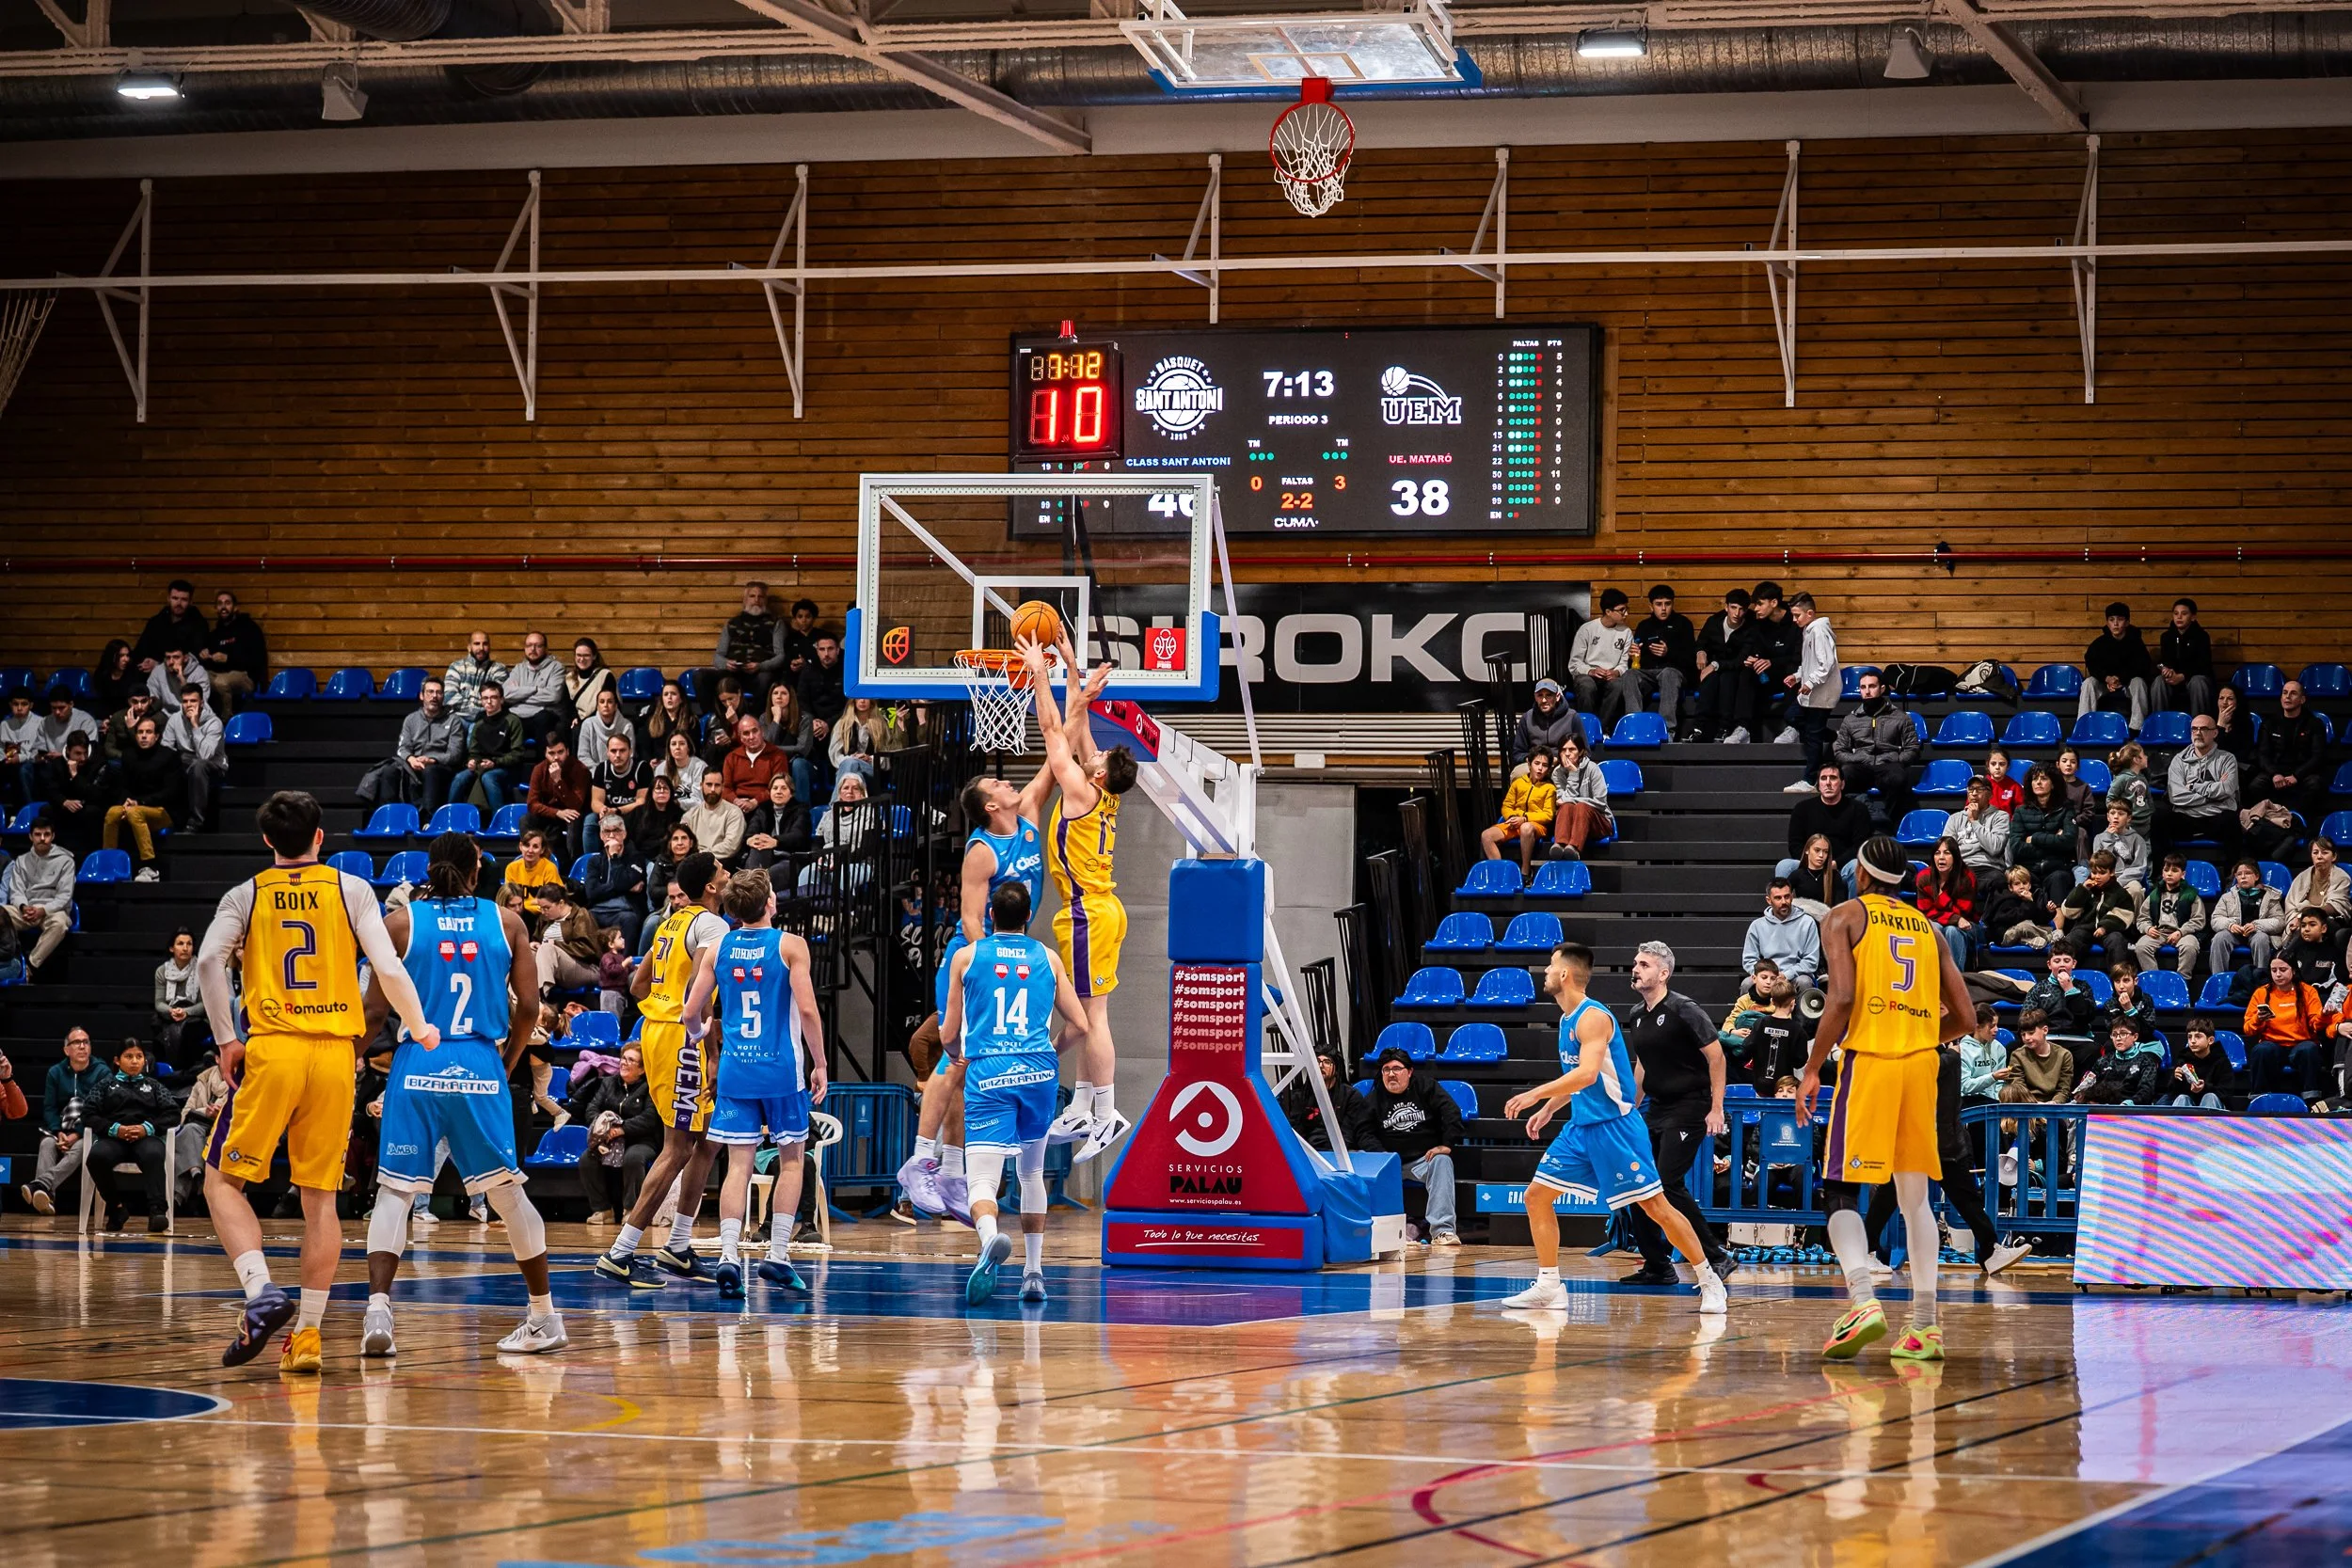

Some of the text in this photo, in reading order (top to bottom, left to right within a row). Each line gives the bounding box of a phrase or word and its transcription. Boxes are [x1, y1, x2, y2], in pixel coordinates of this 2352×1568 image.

[1497, 352, 1563, 361] 0 5
[1497, 364, 1563, 374] 2 2
[1263, 370, 1335, 398] 7:13
[1497, 378, 1563, 387] 5 4
[1136, 387, 1223, 412] SANT ANTONI
[1497, 391, 1562, 401] 6 0
[1048, 386, 1103, 444] 10
[1381, 396, 1462, 425] UEM
[1497, 404, 1563, 413] 8 7
[1269, 415, 1328, 425] PERIODO 3
[1497, 417, 1562, 426] 9 0
[1492, 430, 1562, 439] 15 4
[1248, 439, 1261, 448] TM
[1336, 438, 1349, 447] TM
[1555, 443, 1562, 451] 5
[1126, 457, 1232, 467] CLASS SANT ANTONI
[1389, 452, 1453, 464] UE. MATARÓ
[1554, 456, 1562, 465] 0
[1041, 461, 1110, 470] 19 0
[1281, 477, 1314, 485] FALTAS
[1492, 469, 1561, 479] 50 11
[1250, 476, 1263, 492] 0
[1334, 475, 1346, 490] 3
[1492, 483, 1562, 491] 98 0
[1041, 499, 1110, 510] 99 0
[1280, 492, 1313, 509] 2-2
[1390, 479, 1450, 516] 38
[1491, 496, 1562, 505] 99 0
[274, 891, 319, 911] BOIX
[1869, 910, 1930, 934] GARRIDO
[281, 919, 318, 990] 2
[729, 945, 767, 960] JOHNSON
[1889, 934, 1915, 992] 5
[1174, 970, 1246, 985] #somsport
[1174, 984, 1246, 998] #somsport
[284, 1001, 349, 1015] Romauto
[450, 972, 473, 1036] 2
[1173, 998, 1245, 1012] #somsport
[740, 990, 762, 1038] 5
[993, 987, 1029, 1037] 14
[1173, 1011, 1244, 1026] #somsport
[1173, 1025, 1244, 1039] #somsport
[1172, 1039, 1244, 1053] #somsport
[672, 1046, 704, 1114] UEM
[1168, 1164, 1243, 1174] SERVICIOS
[1169, 1175, 1243, 1195] PALAU
[1168, 1197, 1242, 1206] www.serviciospalau.es
[1143, 1229, 1260, 1242] Todo lo que necesitas
